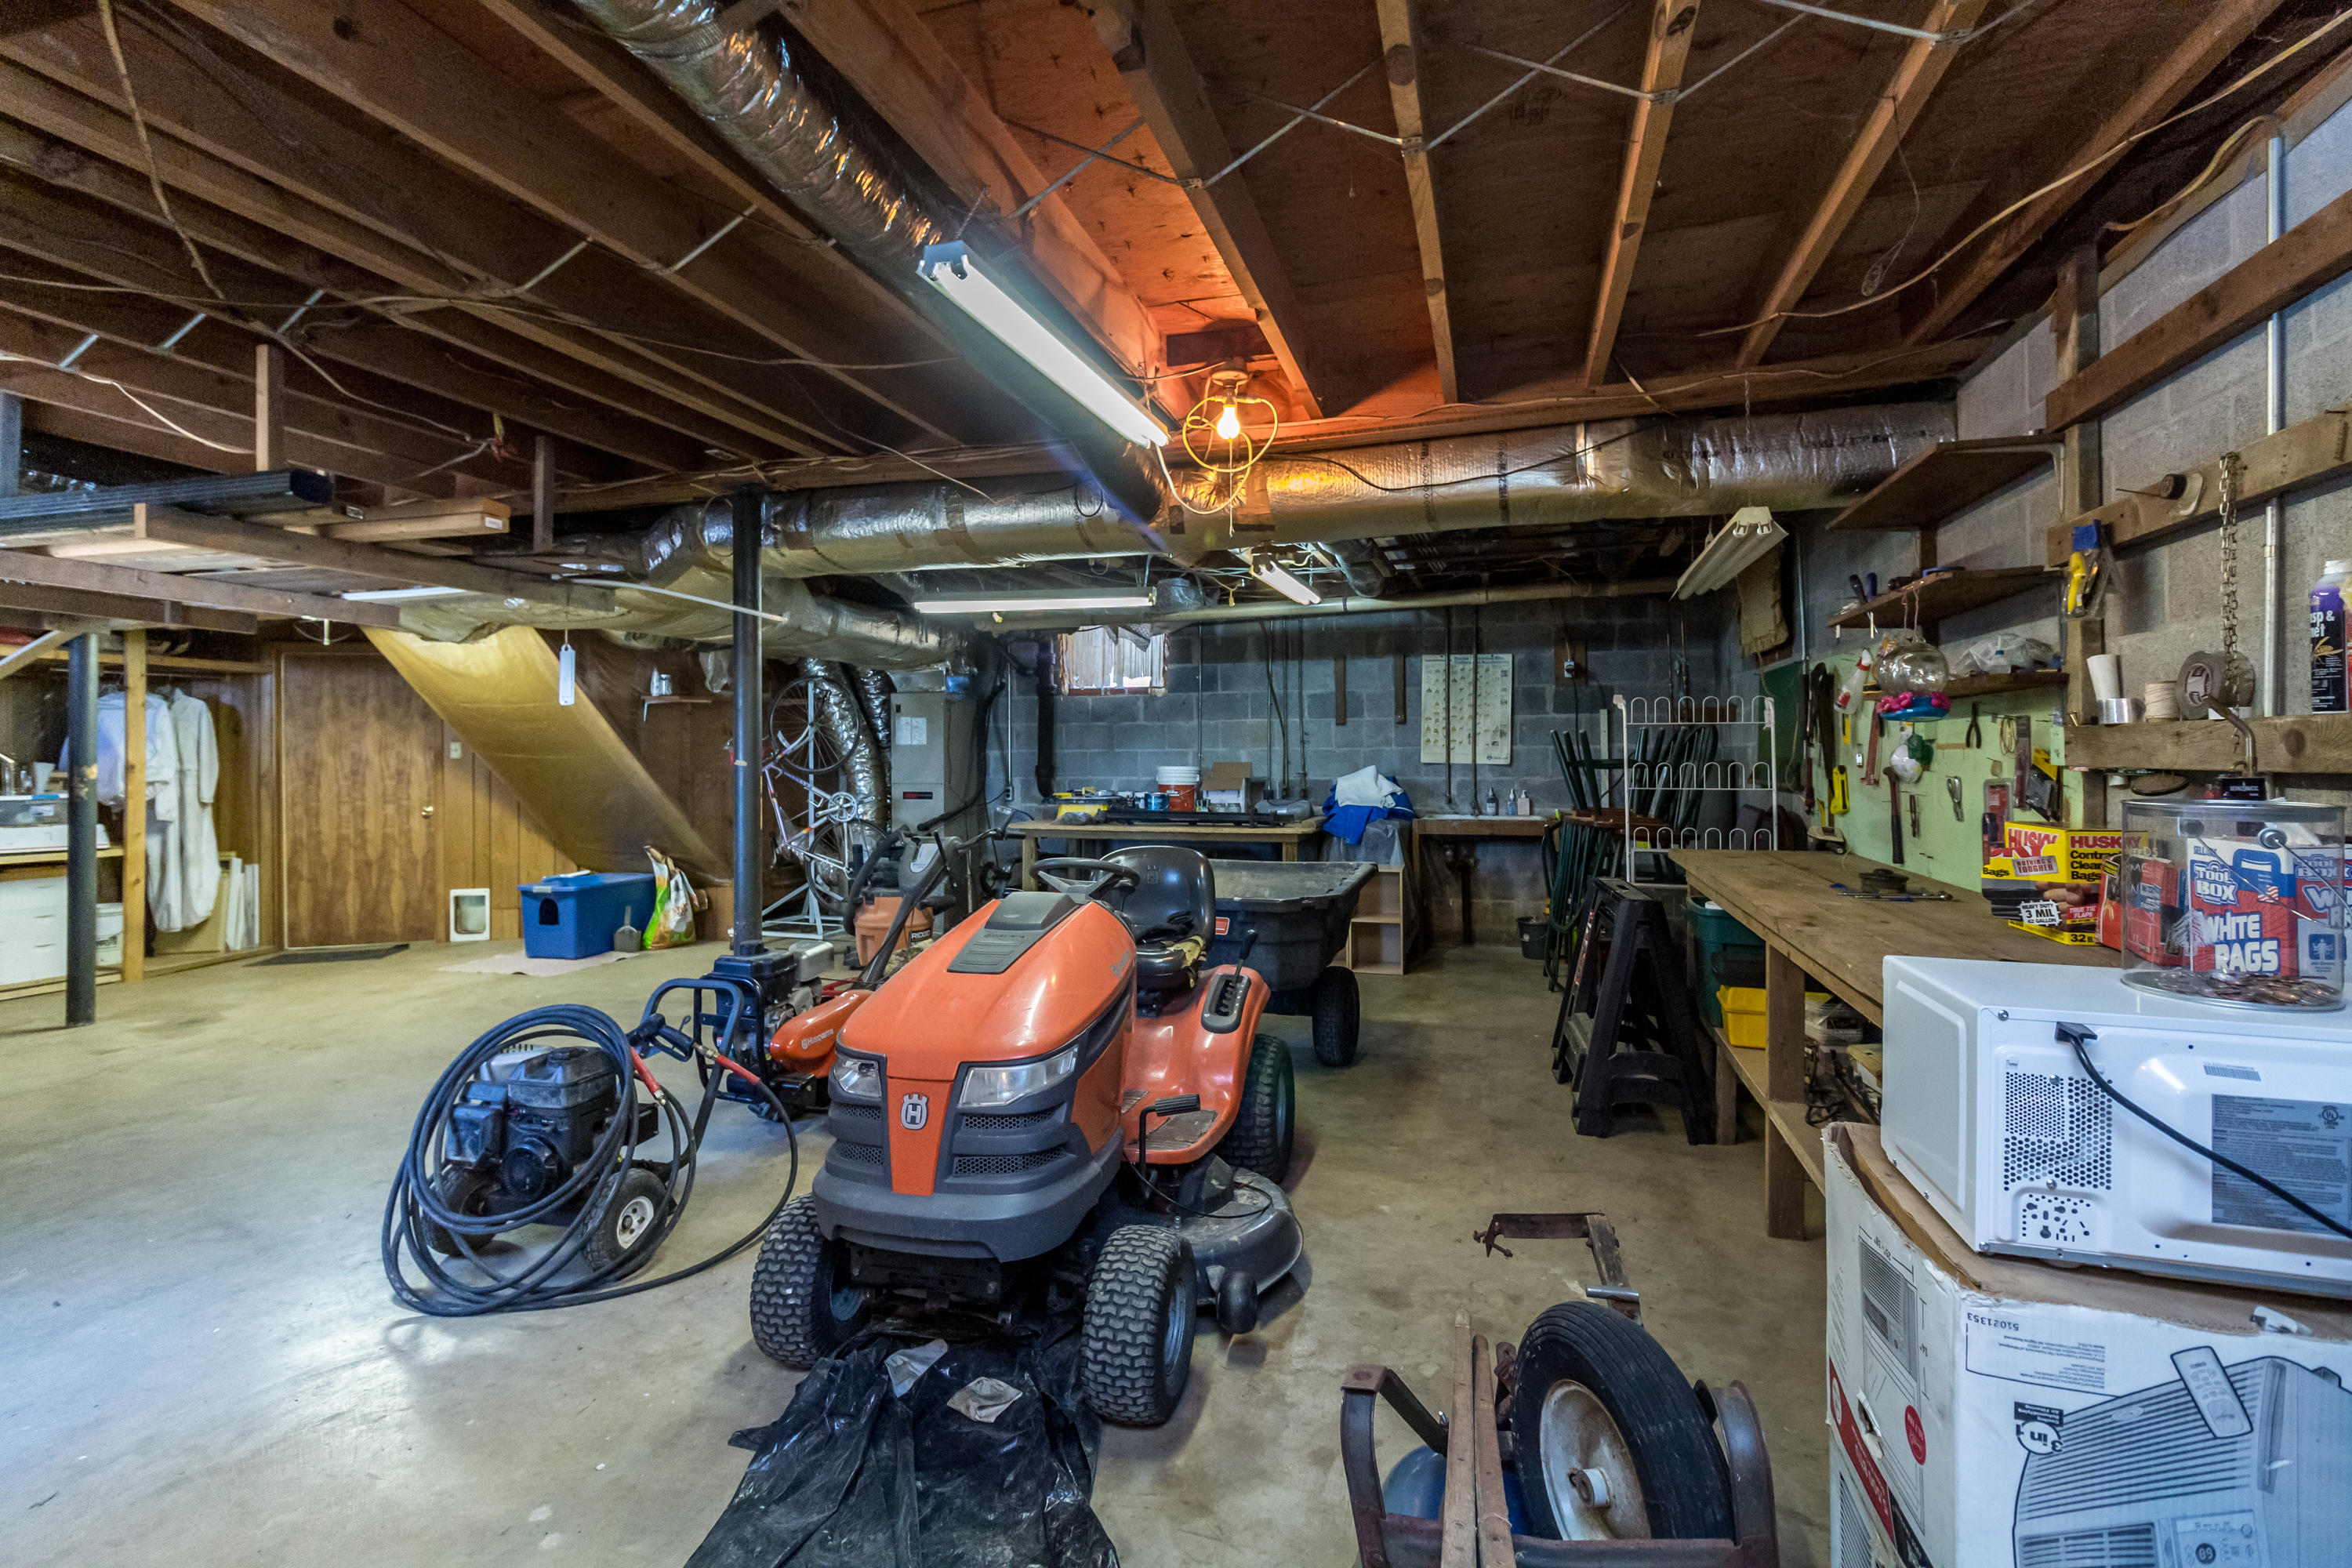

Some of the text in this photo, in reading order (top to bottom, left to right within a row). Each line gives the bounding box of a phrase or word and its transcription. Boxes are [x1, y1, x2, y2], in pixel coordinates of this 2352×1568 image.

[1983, 866, 2009, 877] Bags
[2197, 880, 2236, 901] BOX
[2025, 909, 2056, 918] 3 MIL
[2197, 909, 2261, 941] WHITE
[2071, 934, 2086, 942] 32
[2216, 941, 2279, 972] RAGS
[1966, 1312, 2020, 1332] 51021353
[2016, 1424, 2063, 1453] 3 in 1
